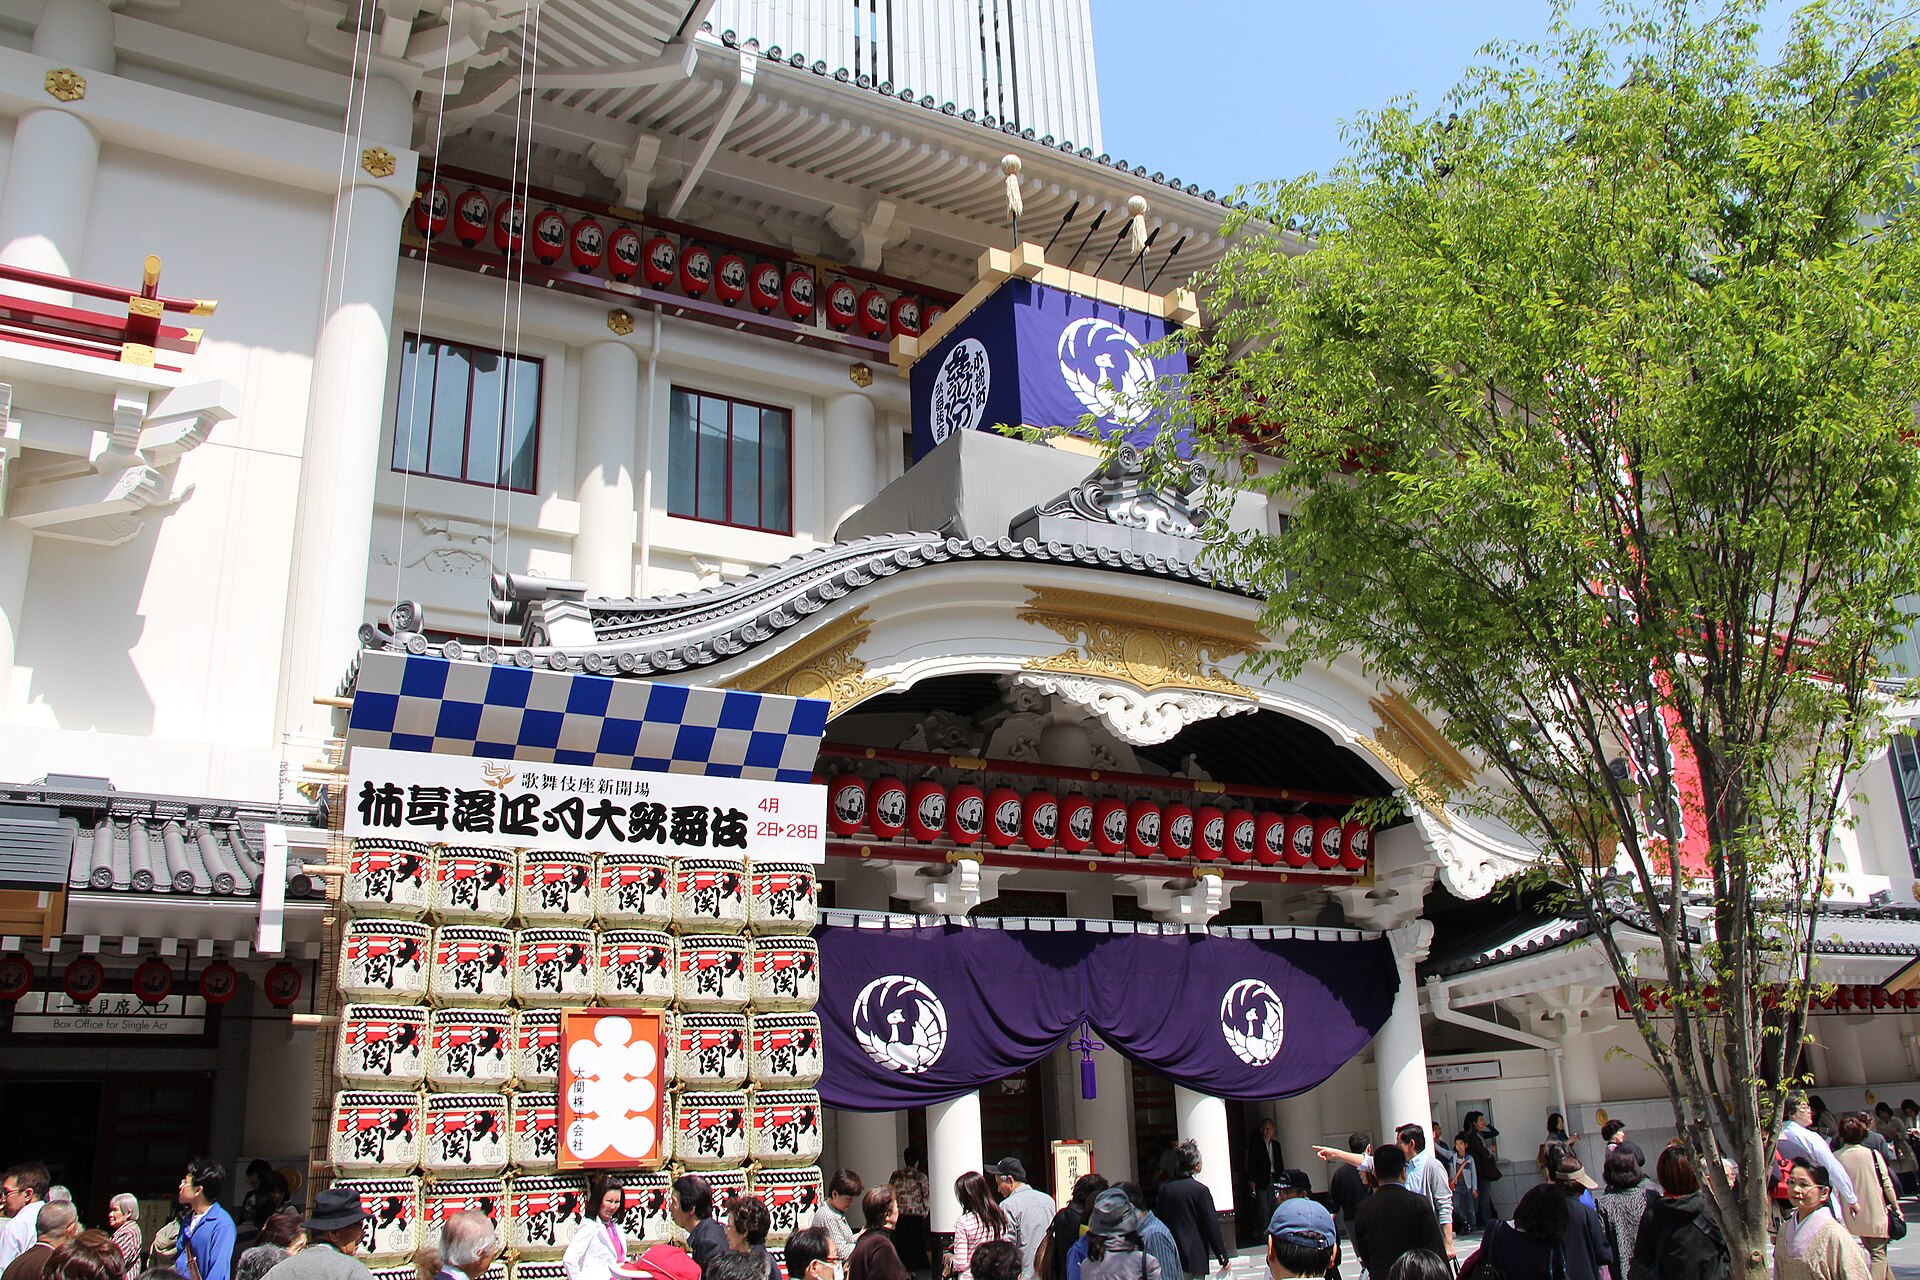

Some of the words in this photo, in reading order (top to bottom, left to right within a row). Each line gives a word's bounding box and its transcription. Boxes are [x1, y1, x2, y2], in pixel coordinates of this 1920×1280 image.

[521, 771, 650, 798] 歌舞伎座新開場
[757, 797, 779, 813] 4月
[53, 1018, 71, 1029] Box
[75, 1018, 104, 1029] Office
[106, 1018, 119, 1029] for
[121, 1020, 150, 1031] Single
[152, 1020, 168, 1030] Act
[572, 1066, 585, 1151] 大関株式会社
